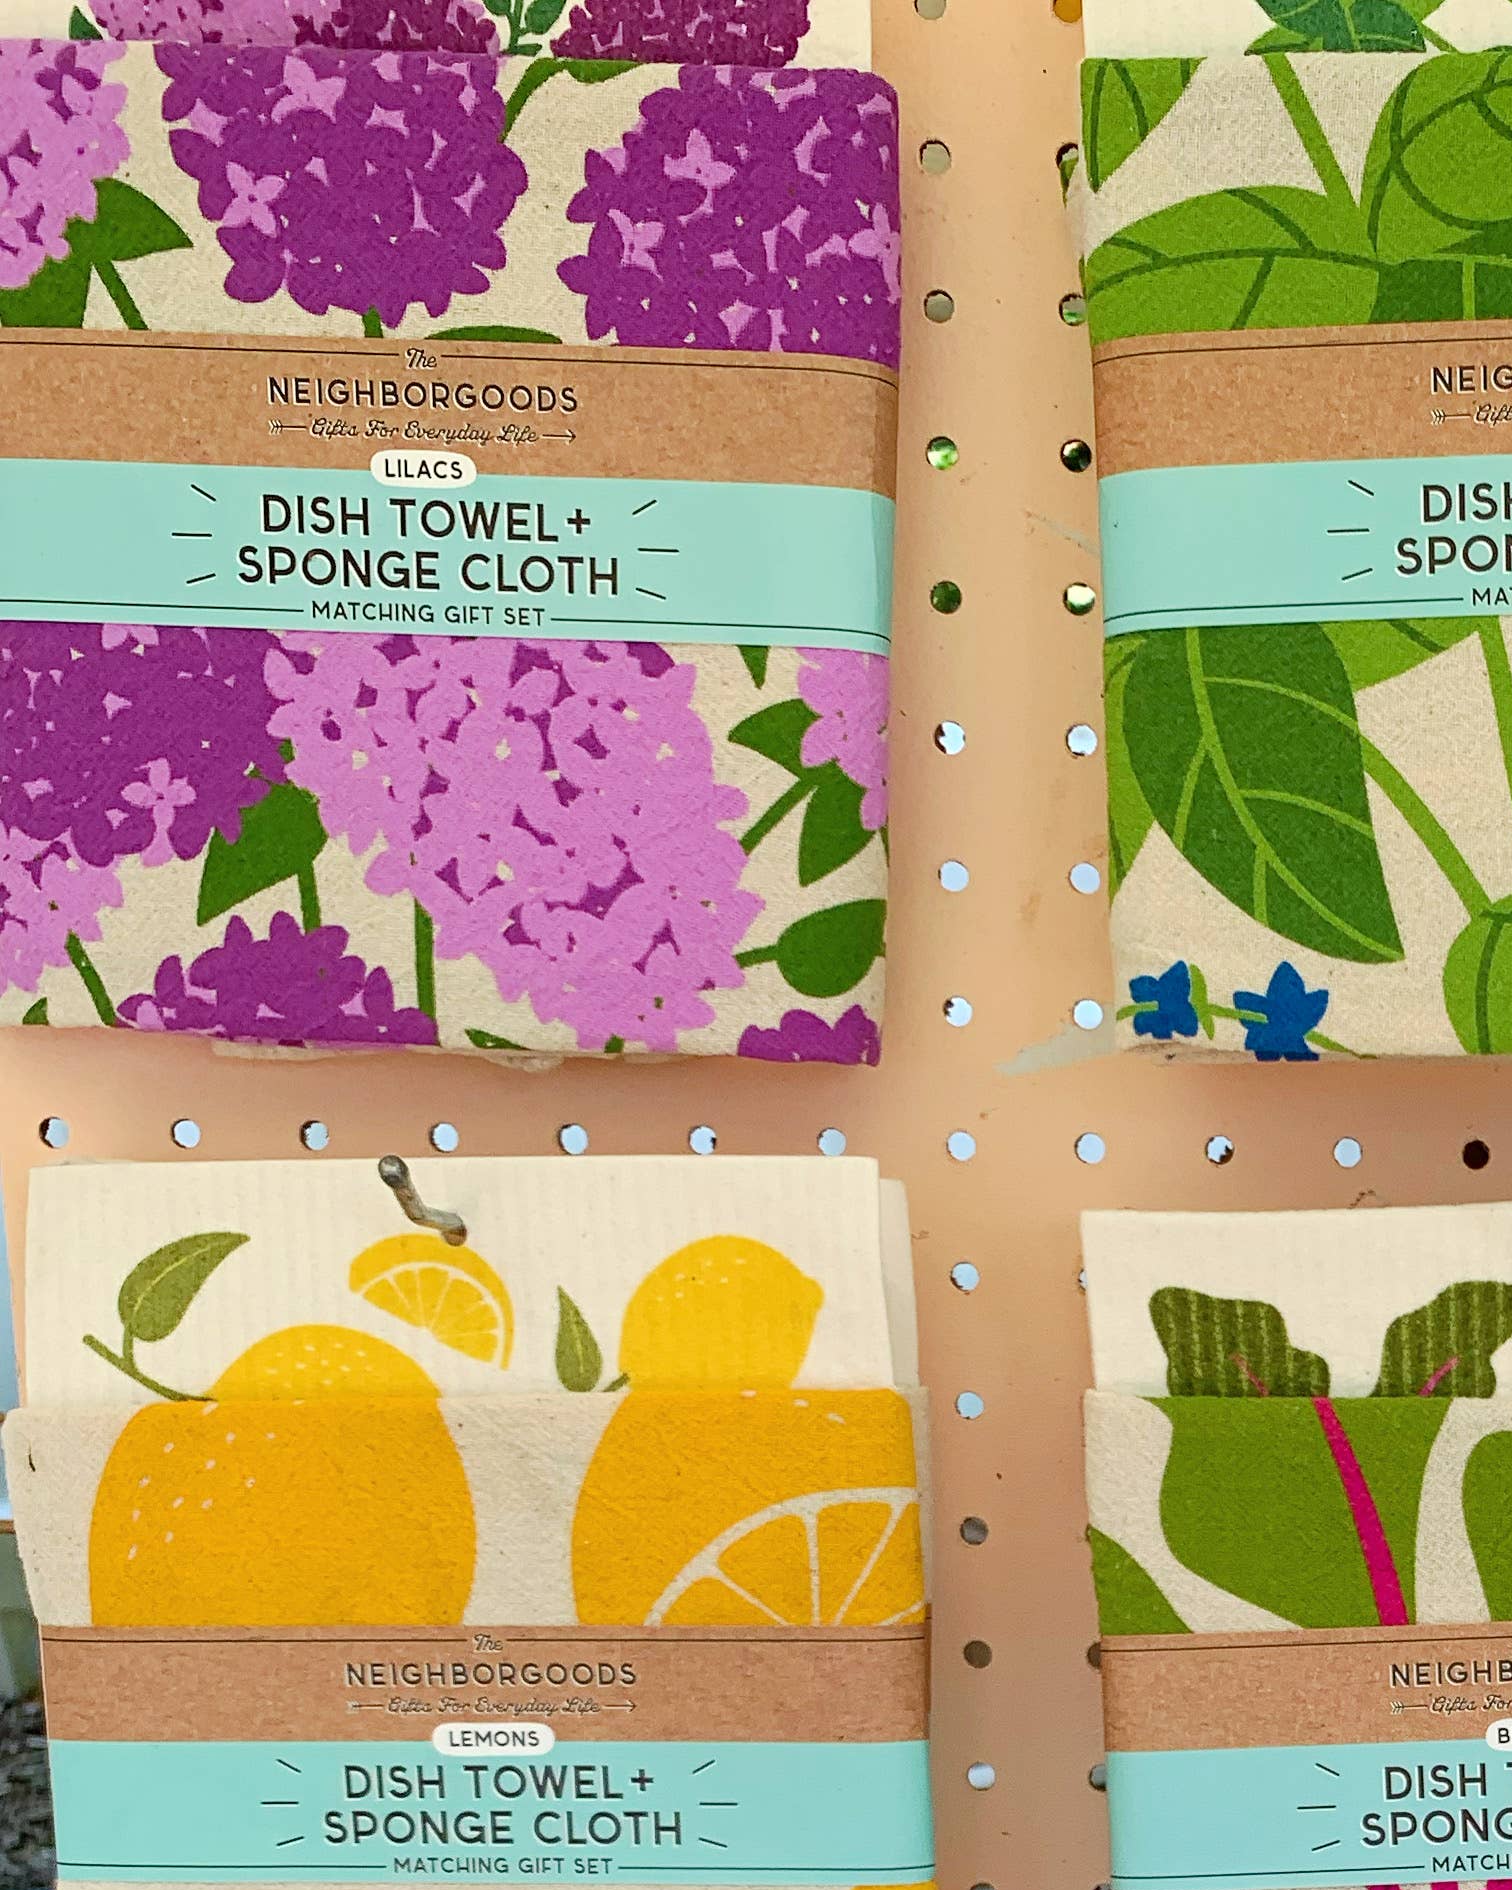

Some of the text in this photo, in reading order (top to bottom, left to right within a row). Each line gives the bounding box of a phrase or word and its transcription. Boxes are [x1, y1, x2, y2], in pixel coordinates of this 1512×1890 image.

[406, 347, 438, 368] The
[269, 376, 578, 411] NEIGHBORGOODS
[311, 417, 540, 446] Gifts For Everyday Life
[384, 458, 463, 479] LILACS
[262, 494, 370, 535] DISH
[238, 545, 618, 595] SPONGE CLOTH
[311, 600, 545, 626] MATCHING GIFT SET
[473, 1633, 504, 1650] The
[346, 1662, 636, 1685] NEIGHBORGOODS
[438, 1695, 471, 1712] For
[474, 1695, 559, 1716] Everyday
[561, 1696, 601, 1715] Life
[1432, 1695, 1478, 1715] Gifts
[449, 1730, 540, 1746] LEMONS
[344, 1765, 445, 1798] DISH
[1384, 1762, 1487, 1799] DISH
[324, 1810, 682, 1844] SPONGE CLOTH
[394, 1857, 613, 1874] MATCHING GIFT SET
